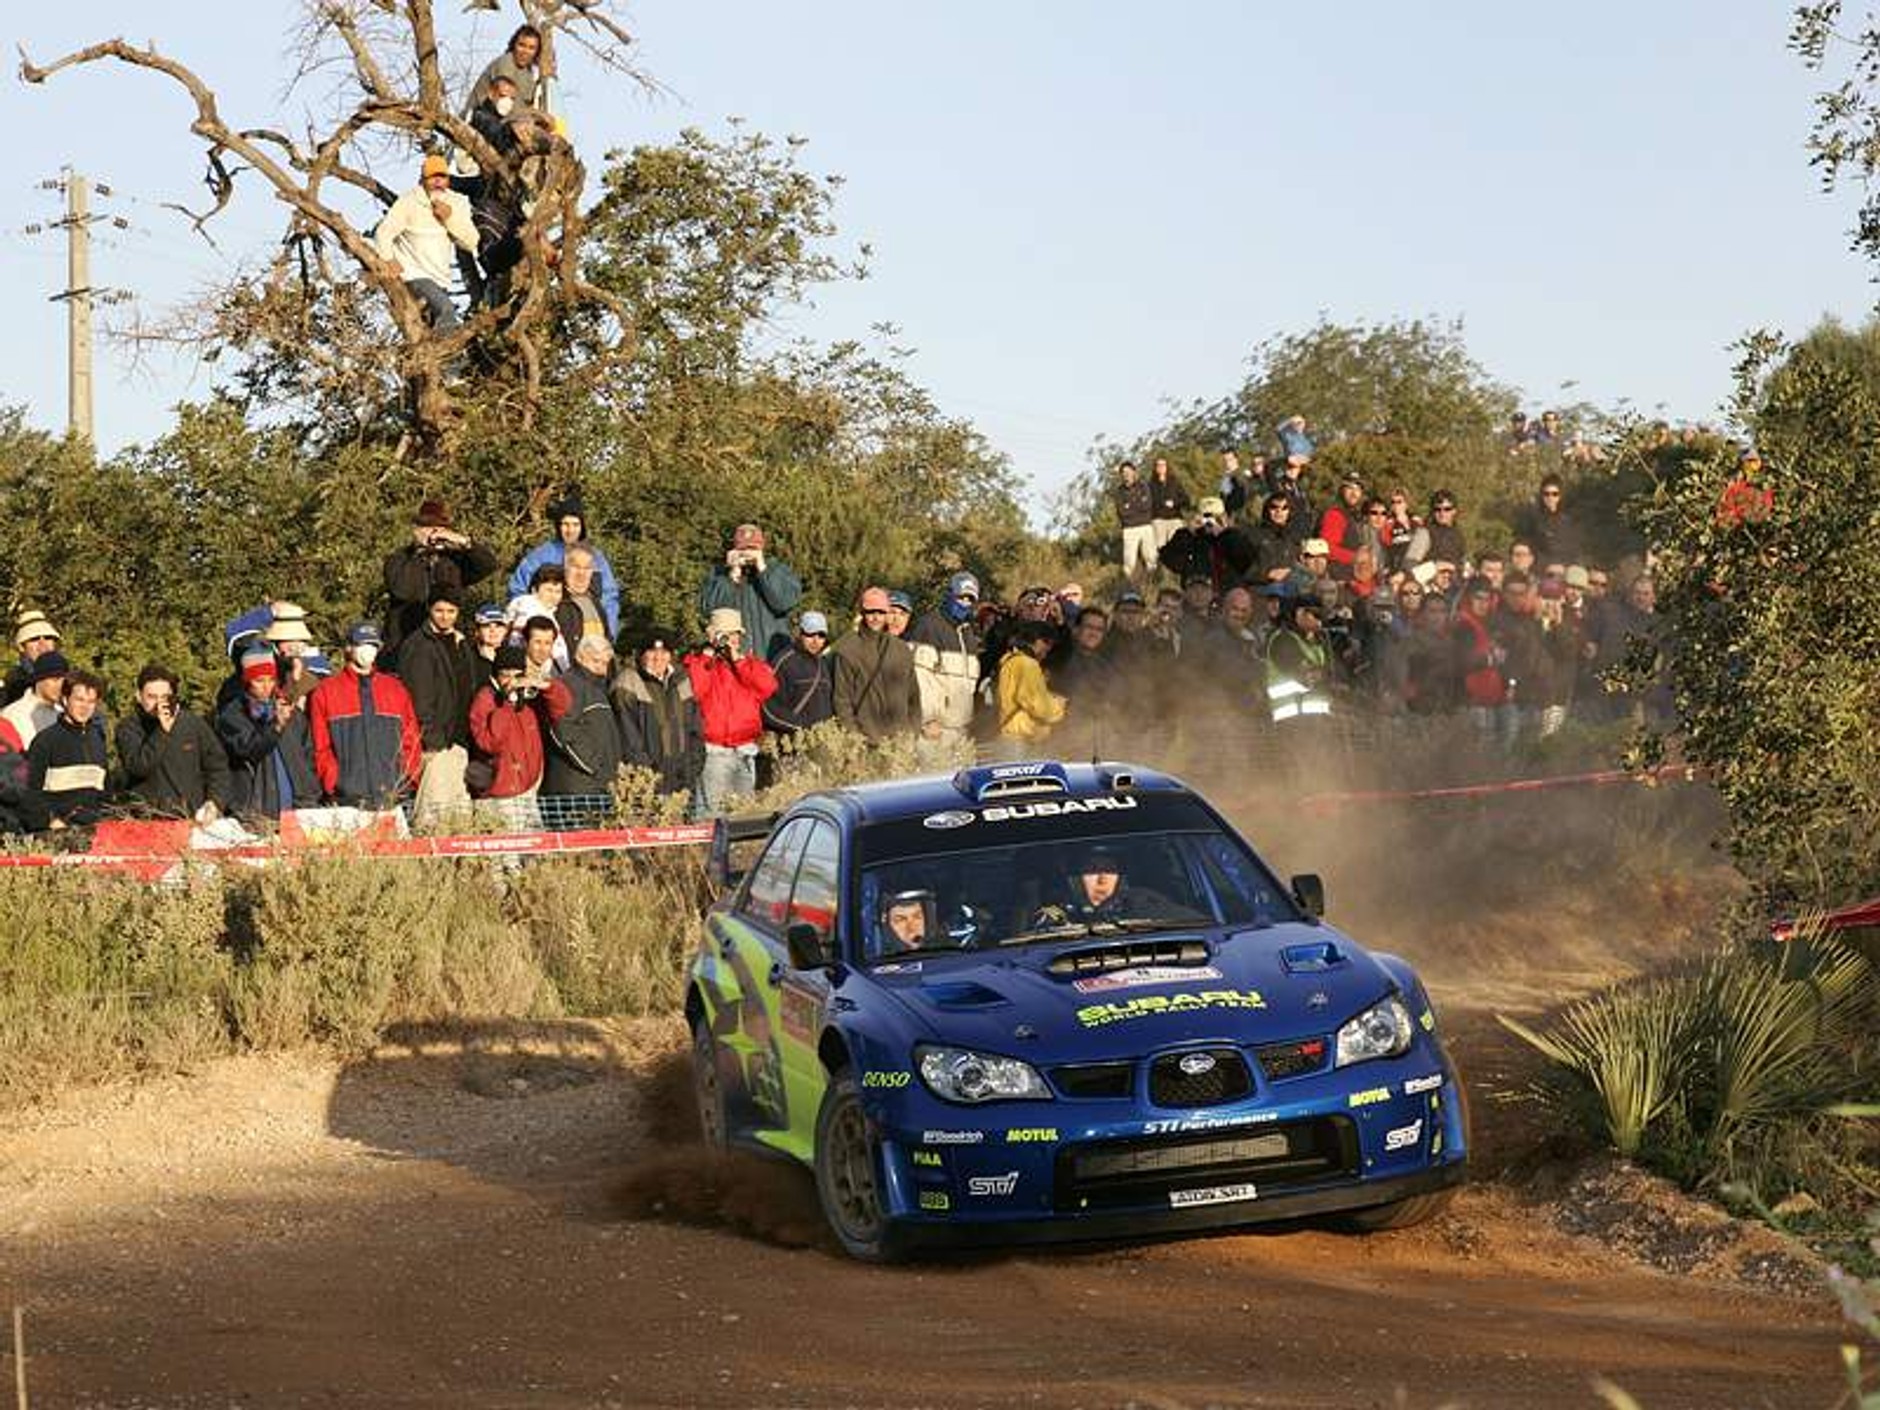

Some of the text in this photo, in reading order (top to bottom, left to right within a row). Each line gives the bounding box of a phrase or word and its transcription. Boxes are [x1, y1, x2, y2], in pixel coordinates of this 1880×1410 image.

[982, 797, 1137, 822] SUBARU
[1077, 991, 1262, 1022] SUBARU
[1085, 1000, 1268, 1028] WORLD RALLY TEAM
[862, 1071, 912, 1088] DENSO
[1006, 1128, 1059, 1142] MOTUL
